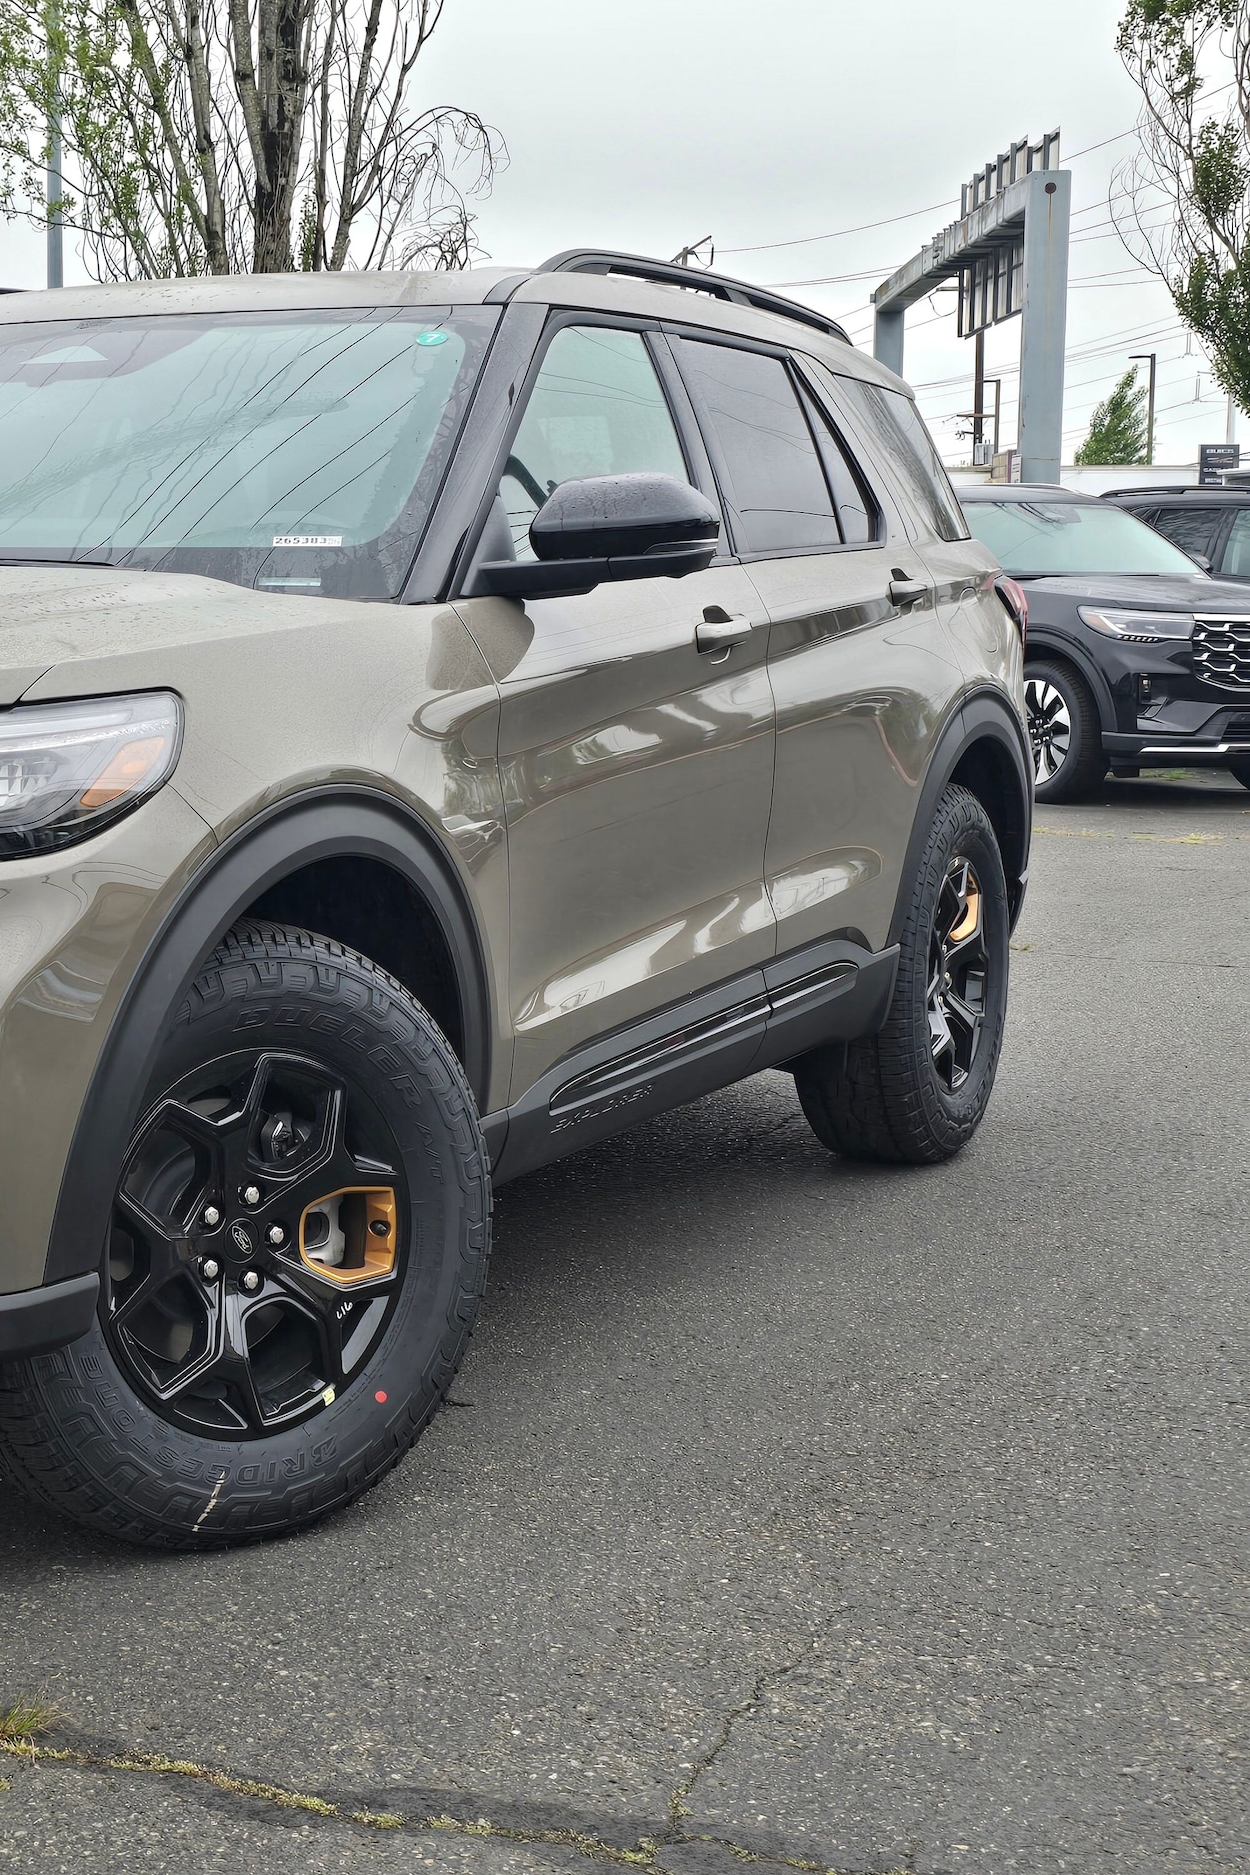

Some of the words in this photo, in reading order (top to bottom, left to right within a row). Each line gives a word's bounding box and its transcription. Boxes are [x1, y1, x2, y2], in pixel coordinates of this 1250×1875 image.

[233, 1005, 423, 1110] DUELER
[550, 1084, 654, 1134] EXPLORER
[78, 1354, 338, 1486] BRIDGESTONE
